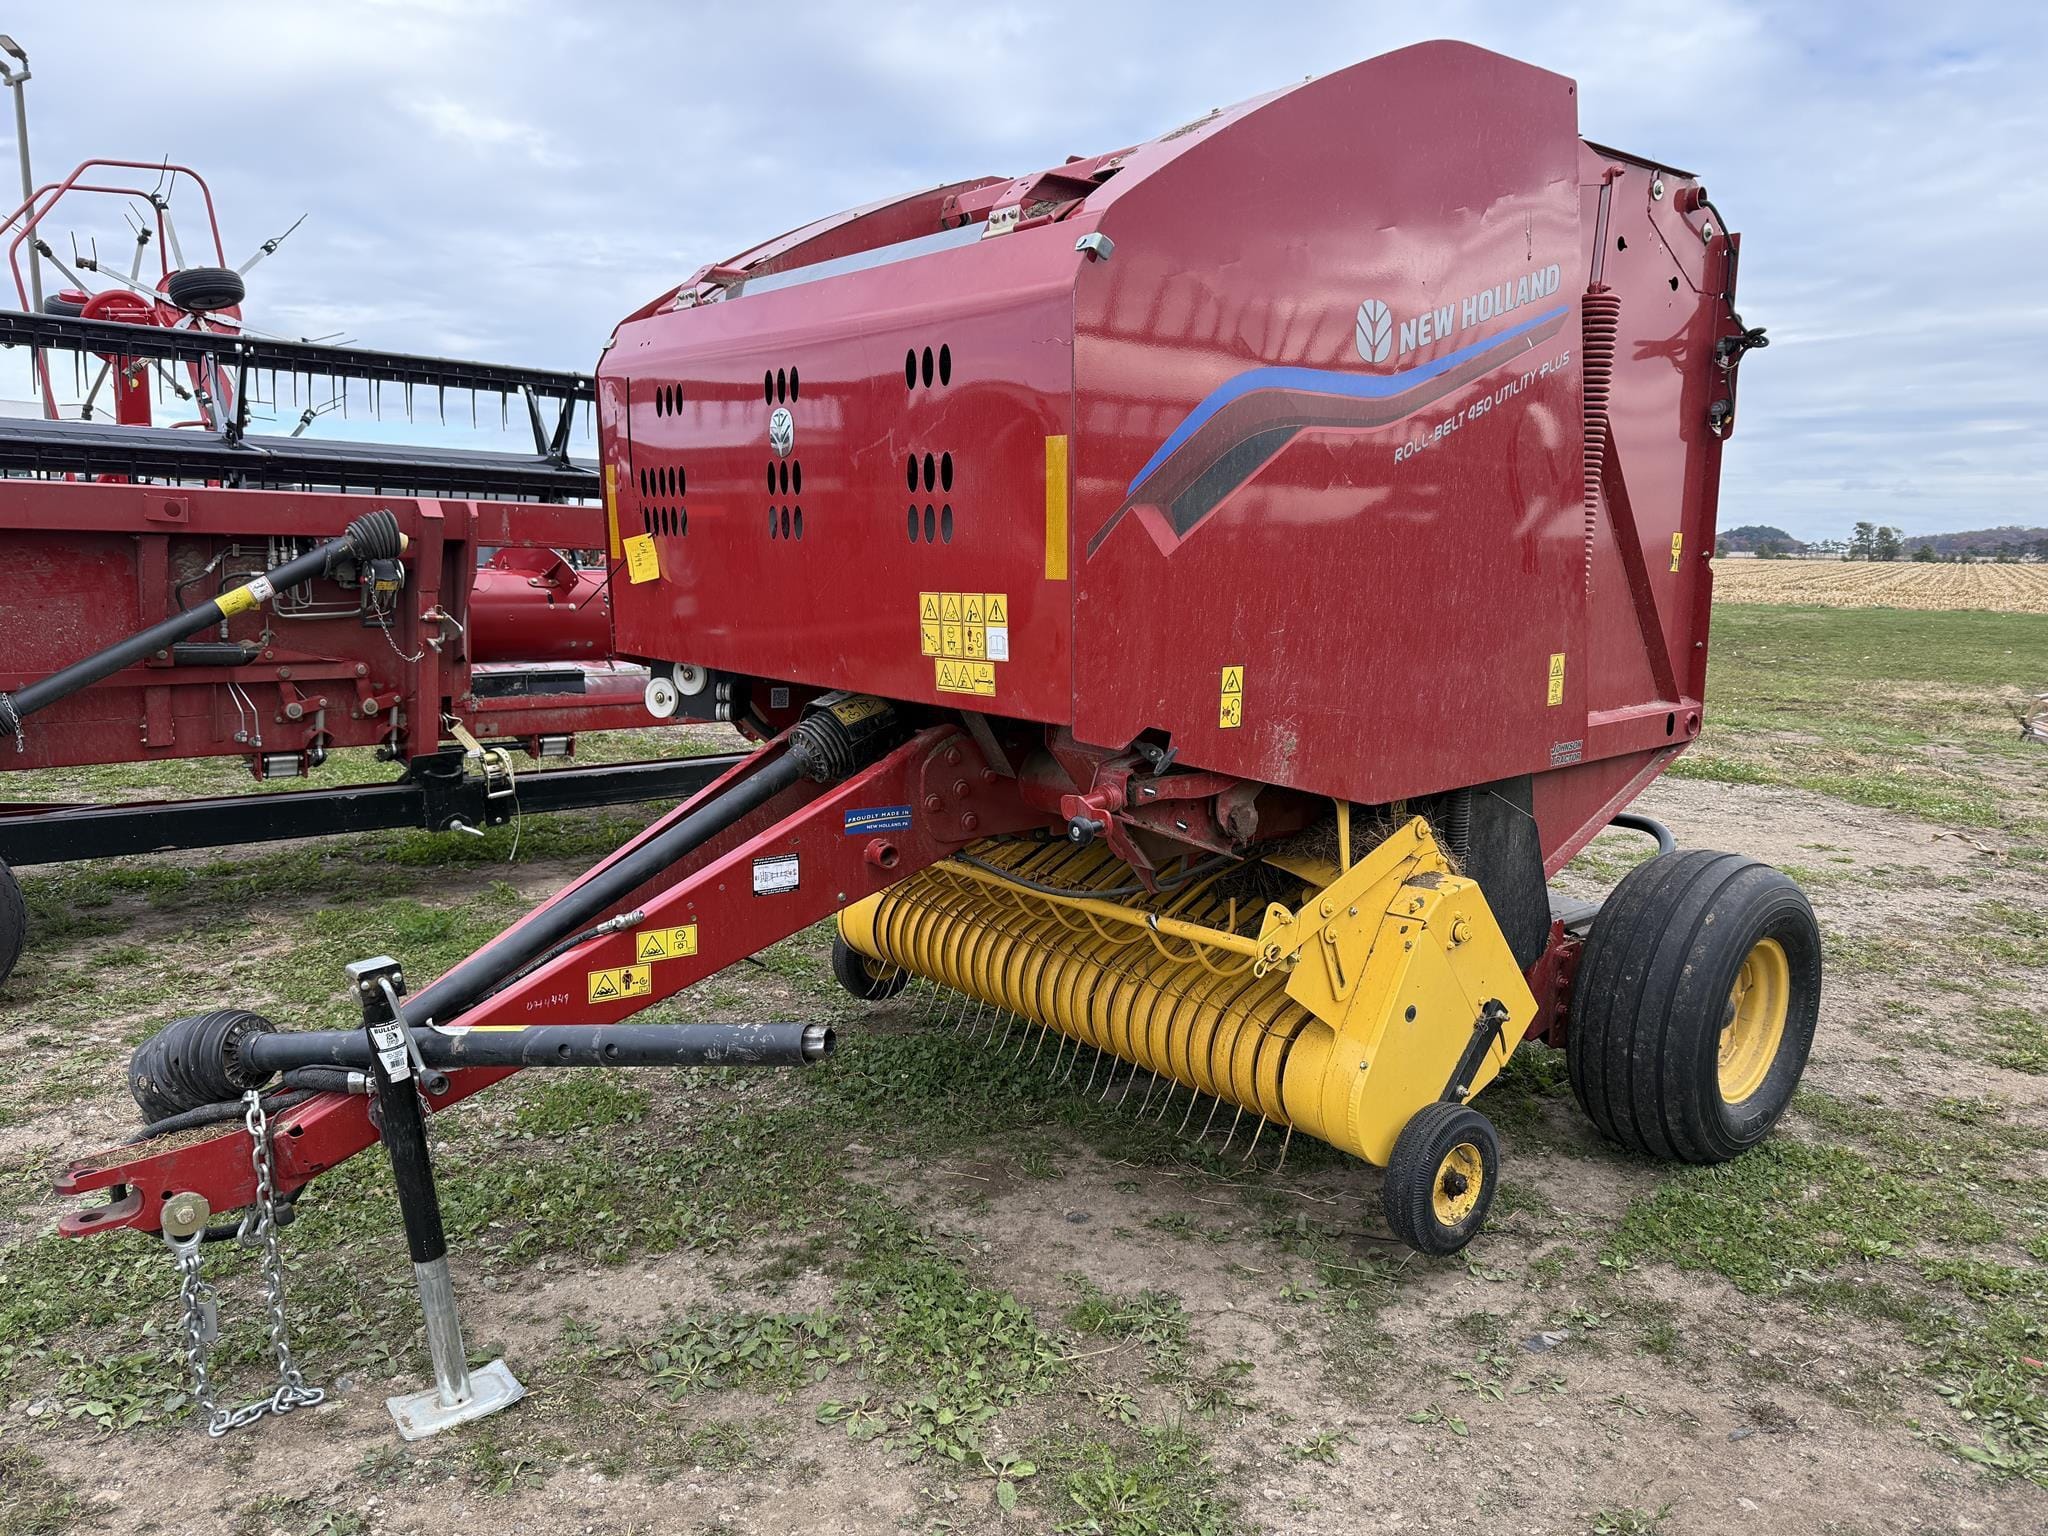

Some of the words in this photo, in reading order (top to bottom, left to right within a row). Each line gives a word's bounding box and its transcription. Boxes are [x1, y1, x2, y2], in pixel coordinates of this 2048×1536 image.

[1399, 303, 1456, 355] NEW
[1461, 263, 1561, 330] HOLLAND
[1394, 410, 1465, 465] ROLL-BELT
[1467, 396, 1492, 420] 450
[1495, 368, 1538, 405] UTILITY
[1539, 350, 1570, 380] PLUS
[847, 813, 879, 823] PROUDLY
